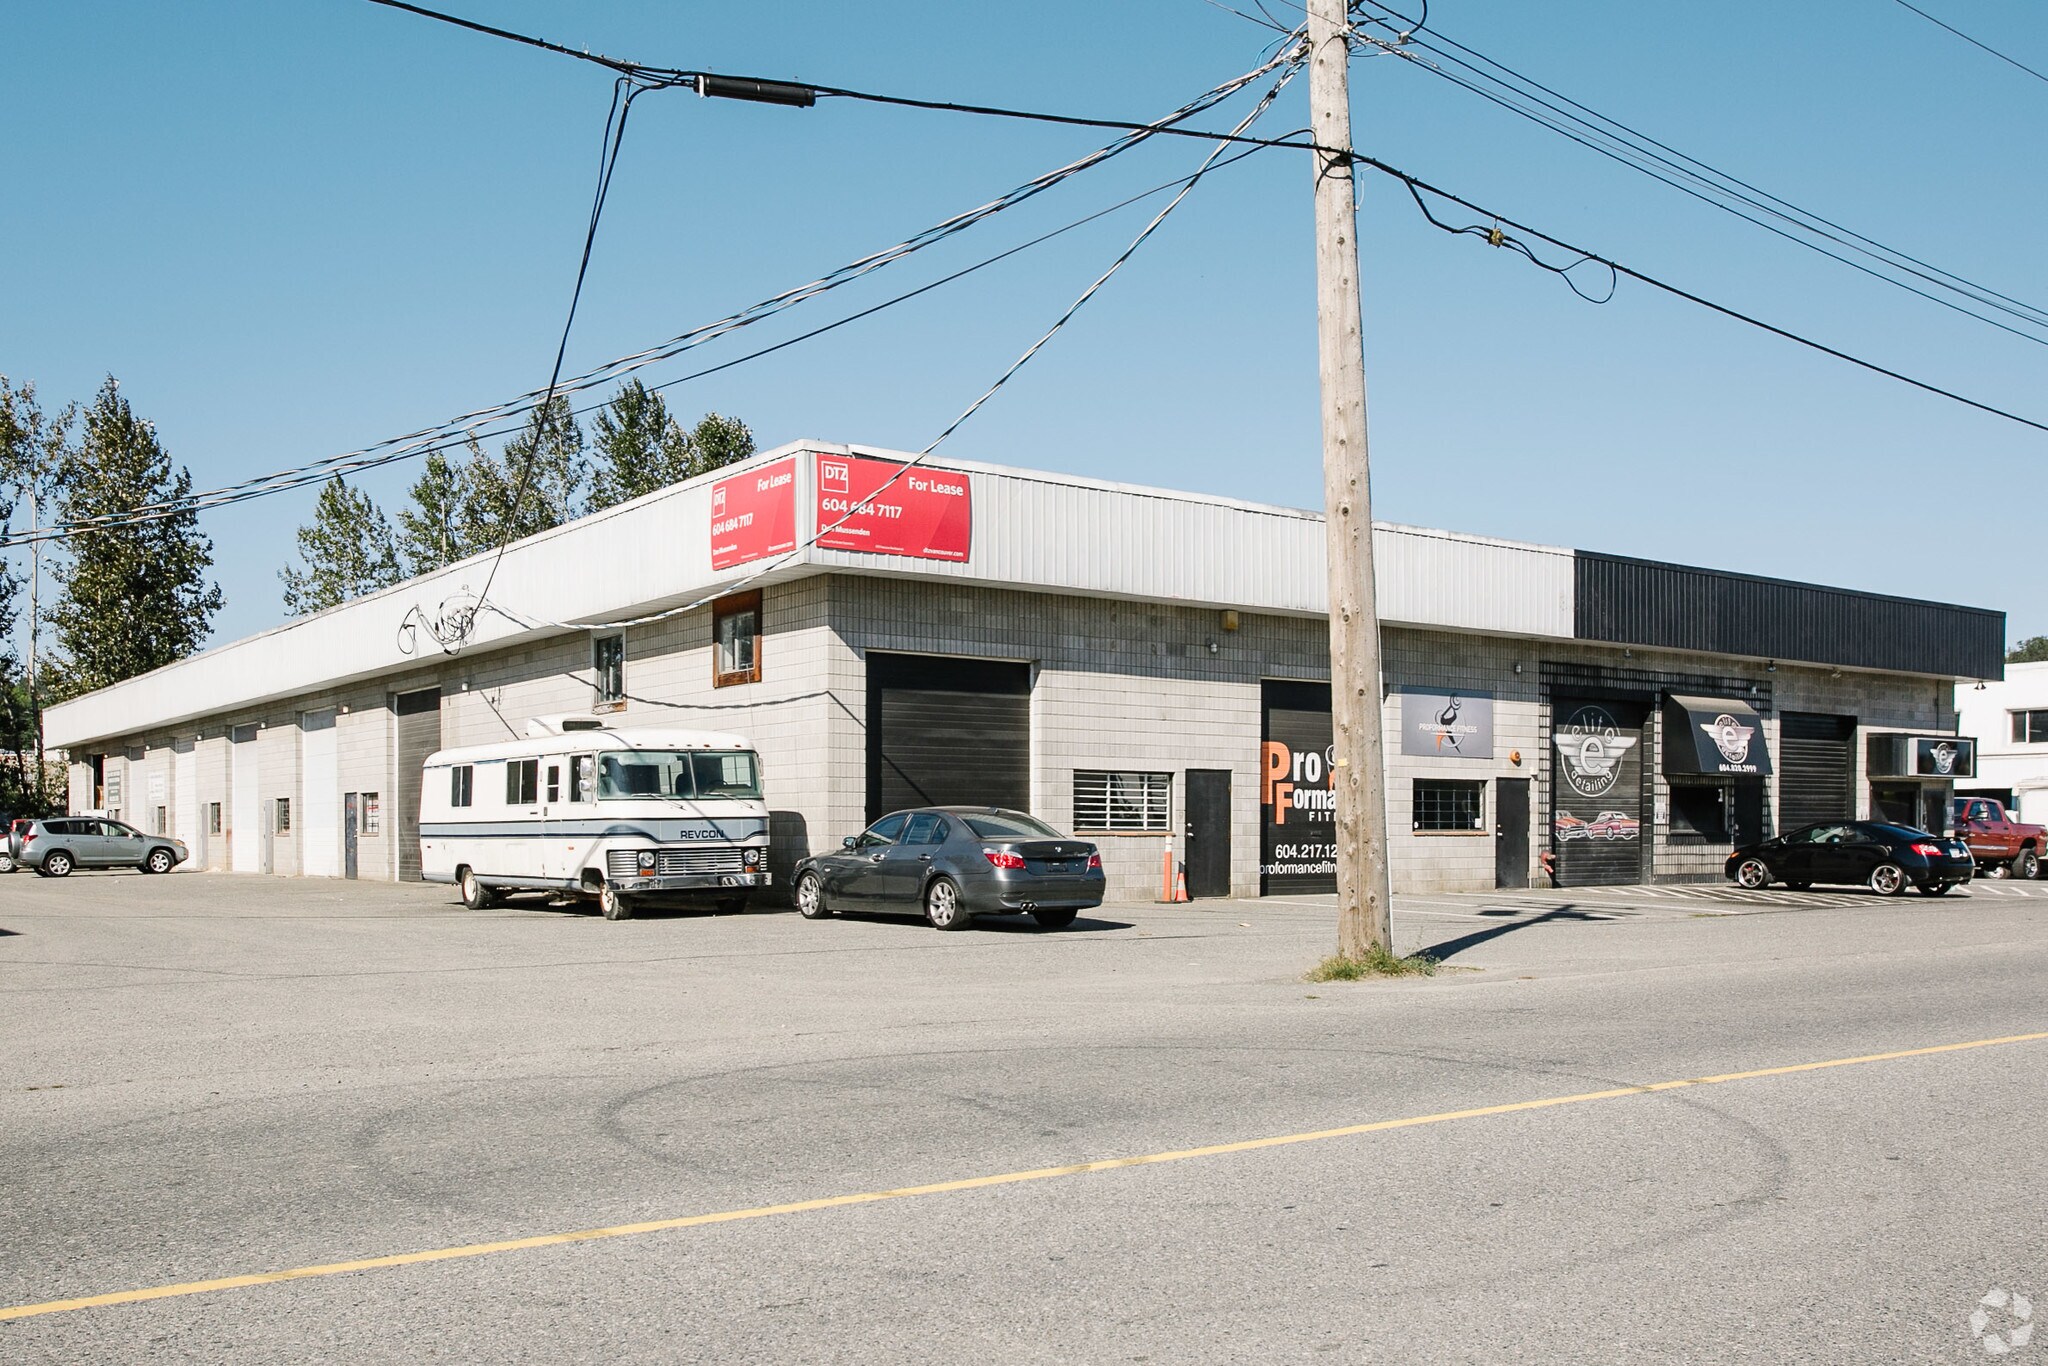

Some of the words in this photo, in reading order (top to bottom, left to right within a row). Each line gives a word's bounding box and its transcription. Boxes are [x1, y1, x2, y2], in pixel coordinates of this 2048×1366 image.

[757, 478, 769, 492] For
[770, 473, 792, 488] Lease
[825, 465, 847, 480] DTZ
[908, 476, 928, 491] For
[930, 480, 964, 496] Lease
[822, 498, 848, 512] 604
[850, 501, 875, 515] 684
[876, 504, 903, 519] 7117
[712, 521, 725, 536] 604
[725, 517, 738, 532] 684
[738, 512, 754, 528] 7117
[1572, 712, 1615, 744] elite
[1580, 736, 1605, 774] e
[1261, 741, 1321, 805] Pro
[1571, 770, 1613, 792] detailing
[680, 830, 724, 839] REVCON
[1275, 844, 1337, 859] 604.217.12
